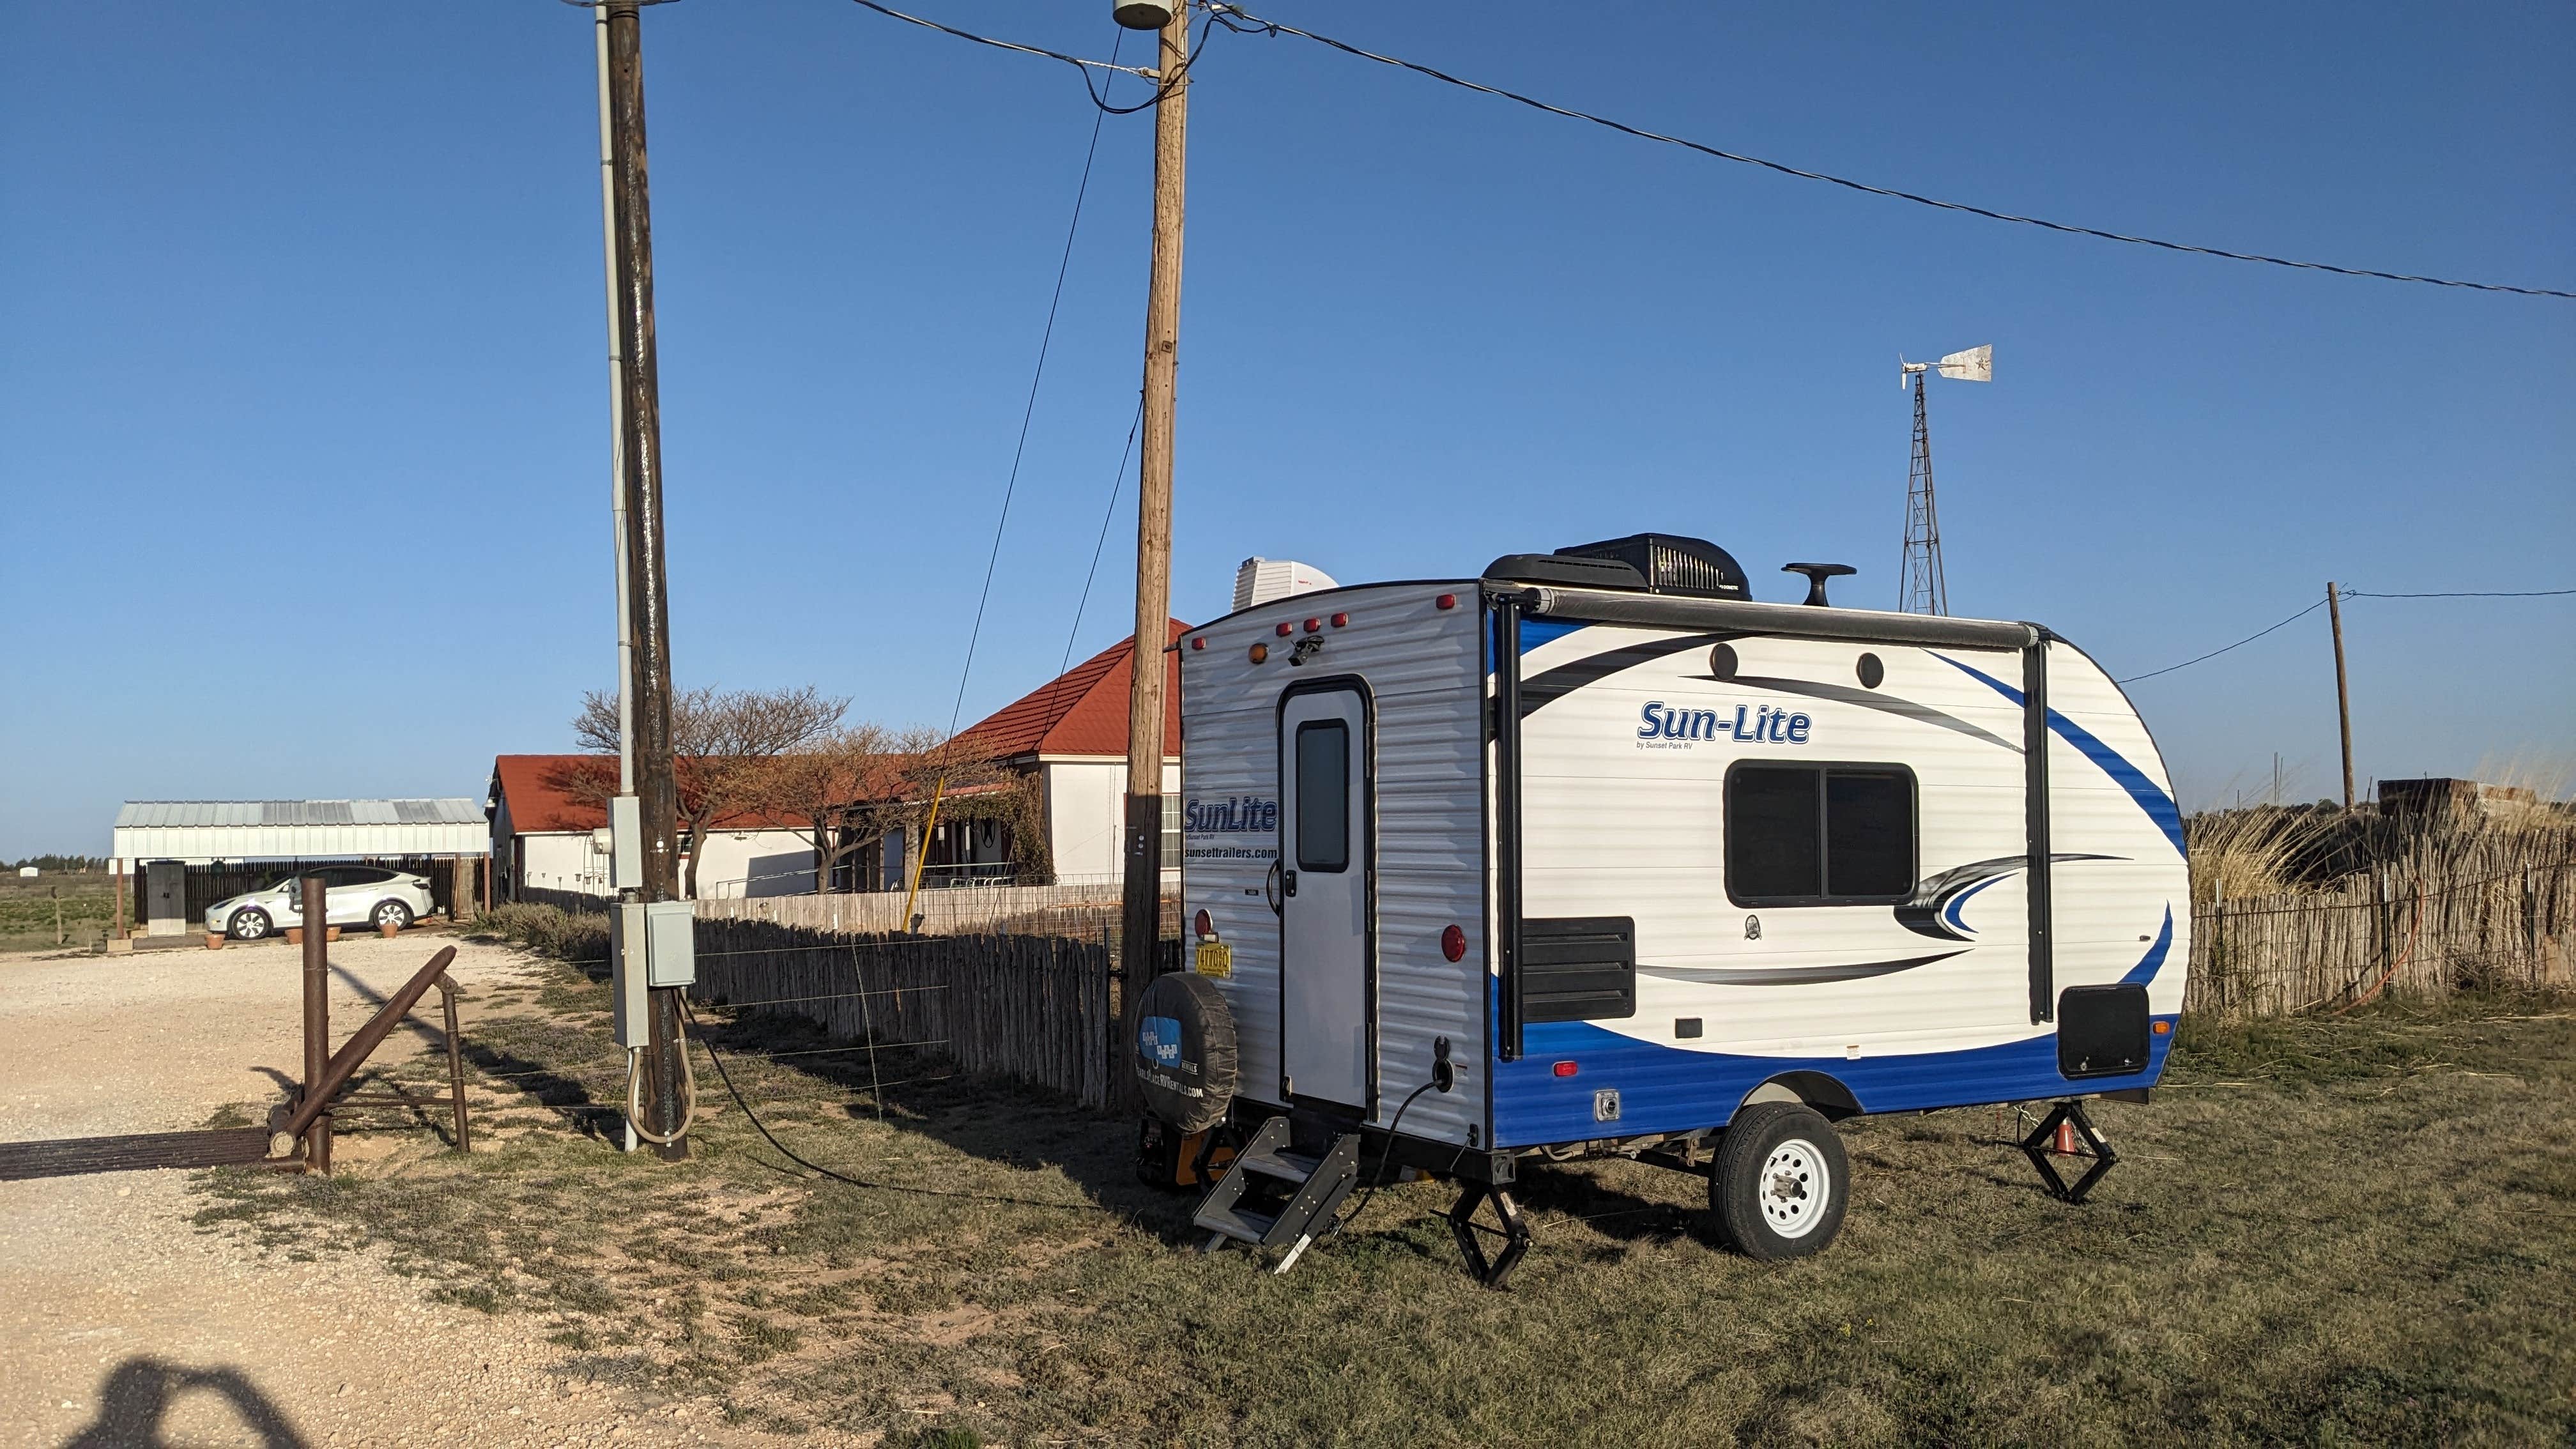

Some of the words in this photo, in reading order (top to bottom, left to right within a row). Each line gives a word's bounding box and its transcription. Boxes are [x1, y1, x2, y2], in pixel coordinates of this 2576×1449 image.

[1637, 701, 1812, 744] Sun-Lite
[1636, 741, 1644, 749] by
[1184, 796, 1278, 832] SunLite
[1184, 847, 1277, 858] sunsettrailers.com
[1181, 1061, 1198, 1073] RENTALS
